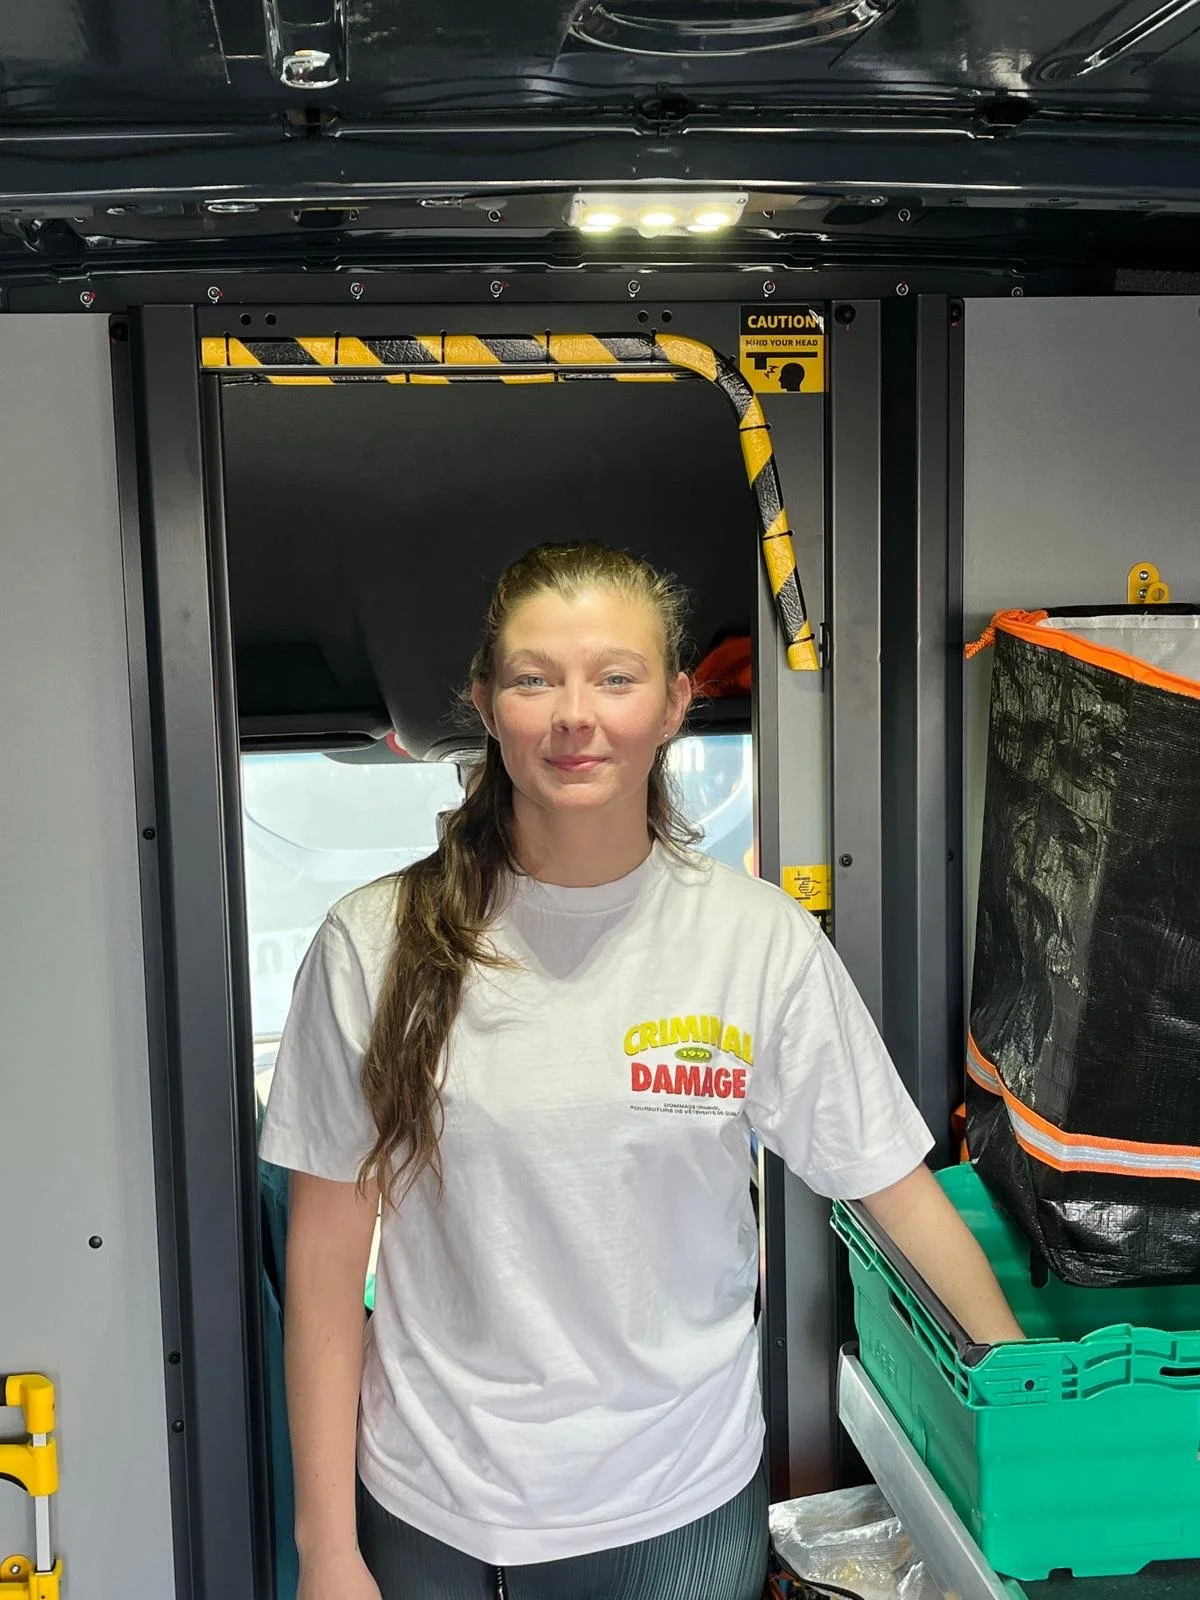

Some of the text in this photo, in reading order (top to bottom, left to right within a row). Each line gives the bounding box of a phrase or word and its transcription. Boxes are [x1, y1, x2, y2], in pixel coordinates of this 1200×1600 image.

[748, 315, 816, 328] CAUTION
[745, 339, 818, 347] MIND YOUR HEAD
[624, 1015, 754, 1066] CRIMINAL
[681, 1050, 710, 1059] 1991
[632, 1062, 746, 1098] DAMAGE
